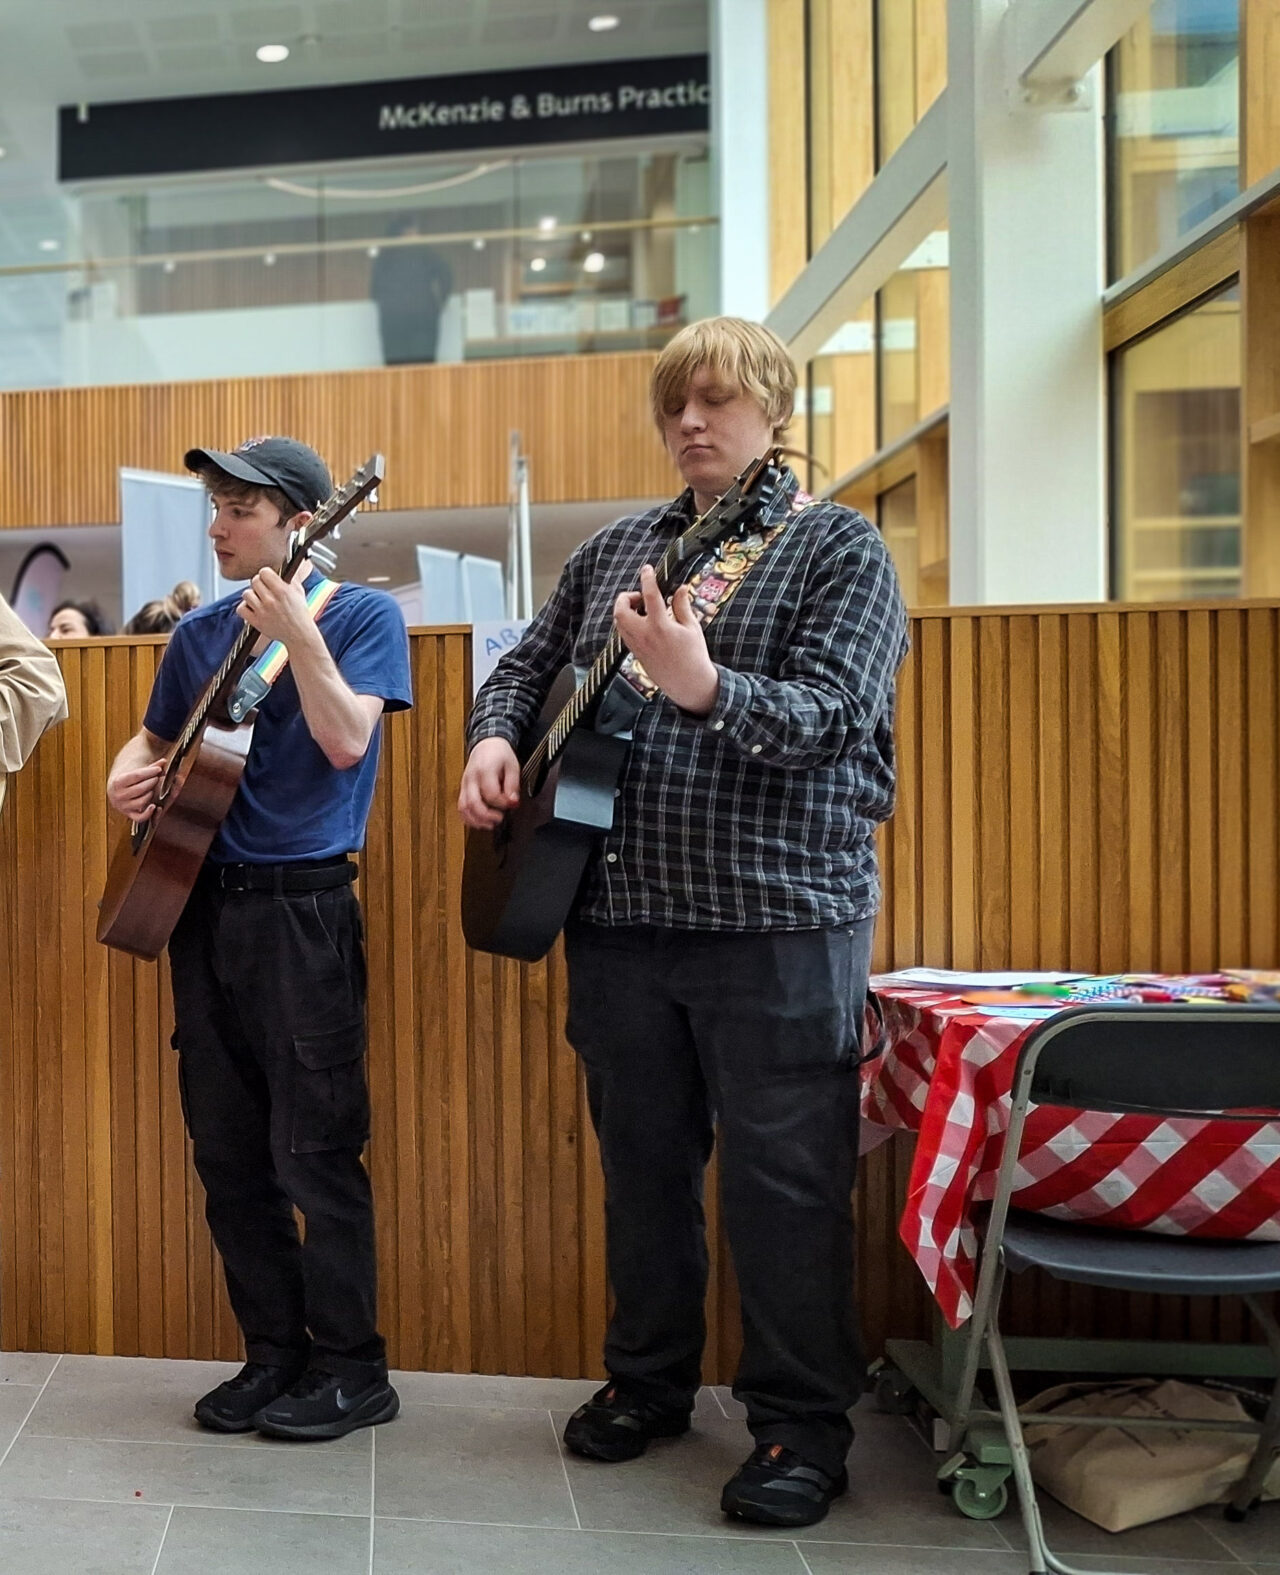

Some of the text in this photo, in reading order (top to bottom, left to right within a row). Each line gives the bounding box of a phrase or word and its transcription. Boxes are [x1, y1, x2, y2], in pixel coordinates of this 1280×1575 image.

[378, 98, 505, 130] McKenzie
[510, 95, 531, 119] &
[536, 91, 613, 118] Burns
[486, 627, 527, 657] AB
